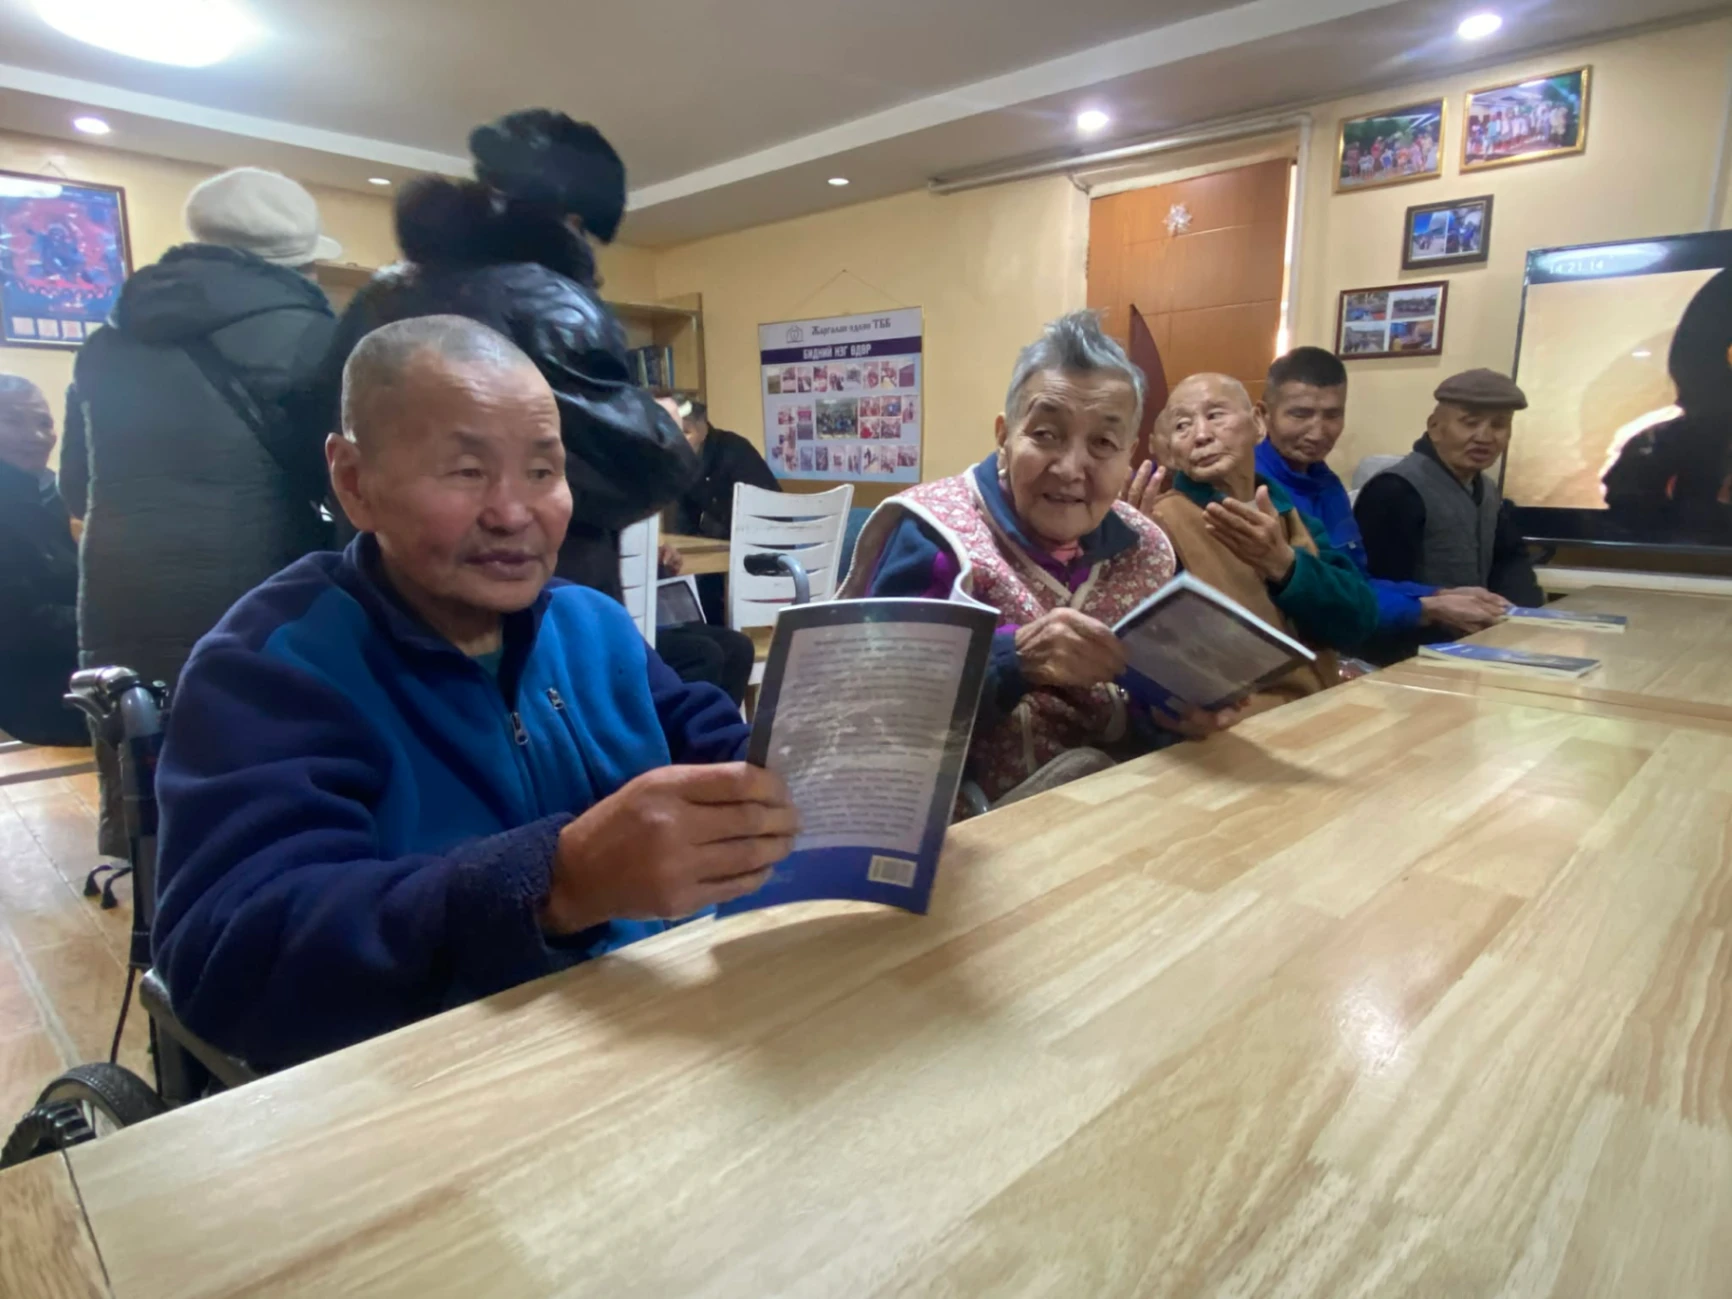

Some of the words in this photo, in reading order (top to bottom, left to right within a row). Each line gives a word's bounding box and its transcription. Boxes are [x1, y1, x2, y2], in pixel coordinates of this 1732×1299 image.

[872, 318, 891, 329] ТББ
[803, 346, 832, 360] БИДНИЙ
[834, 345, 849, 357] НЭГ
[850, 343, 872, 357] ӨДӨР
